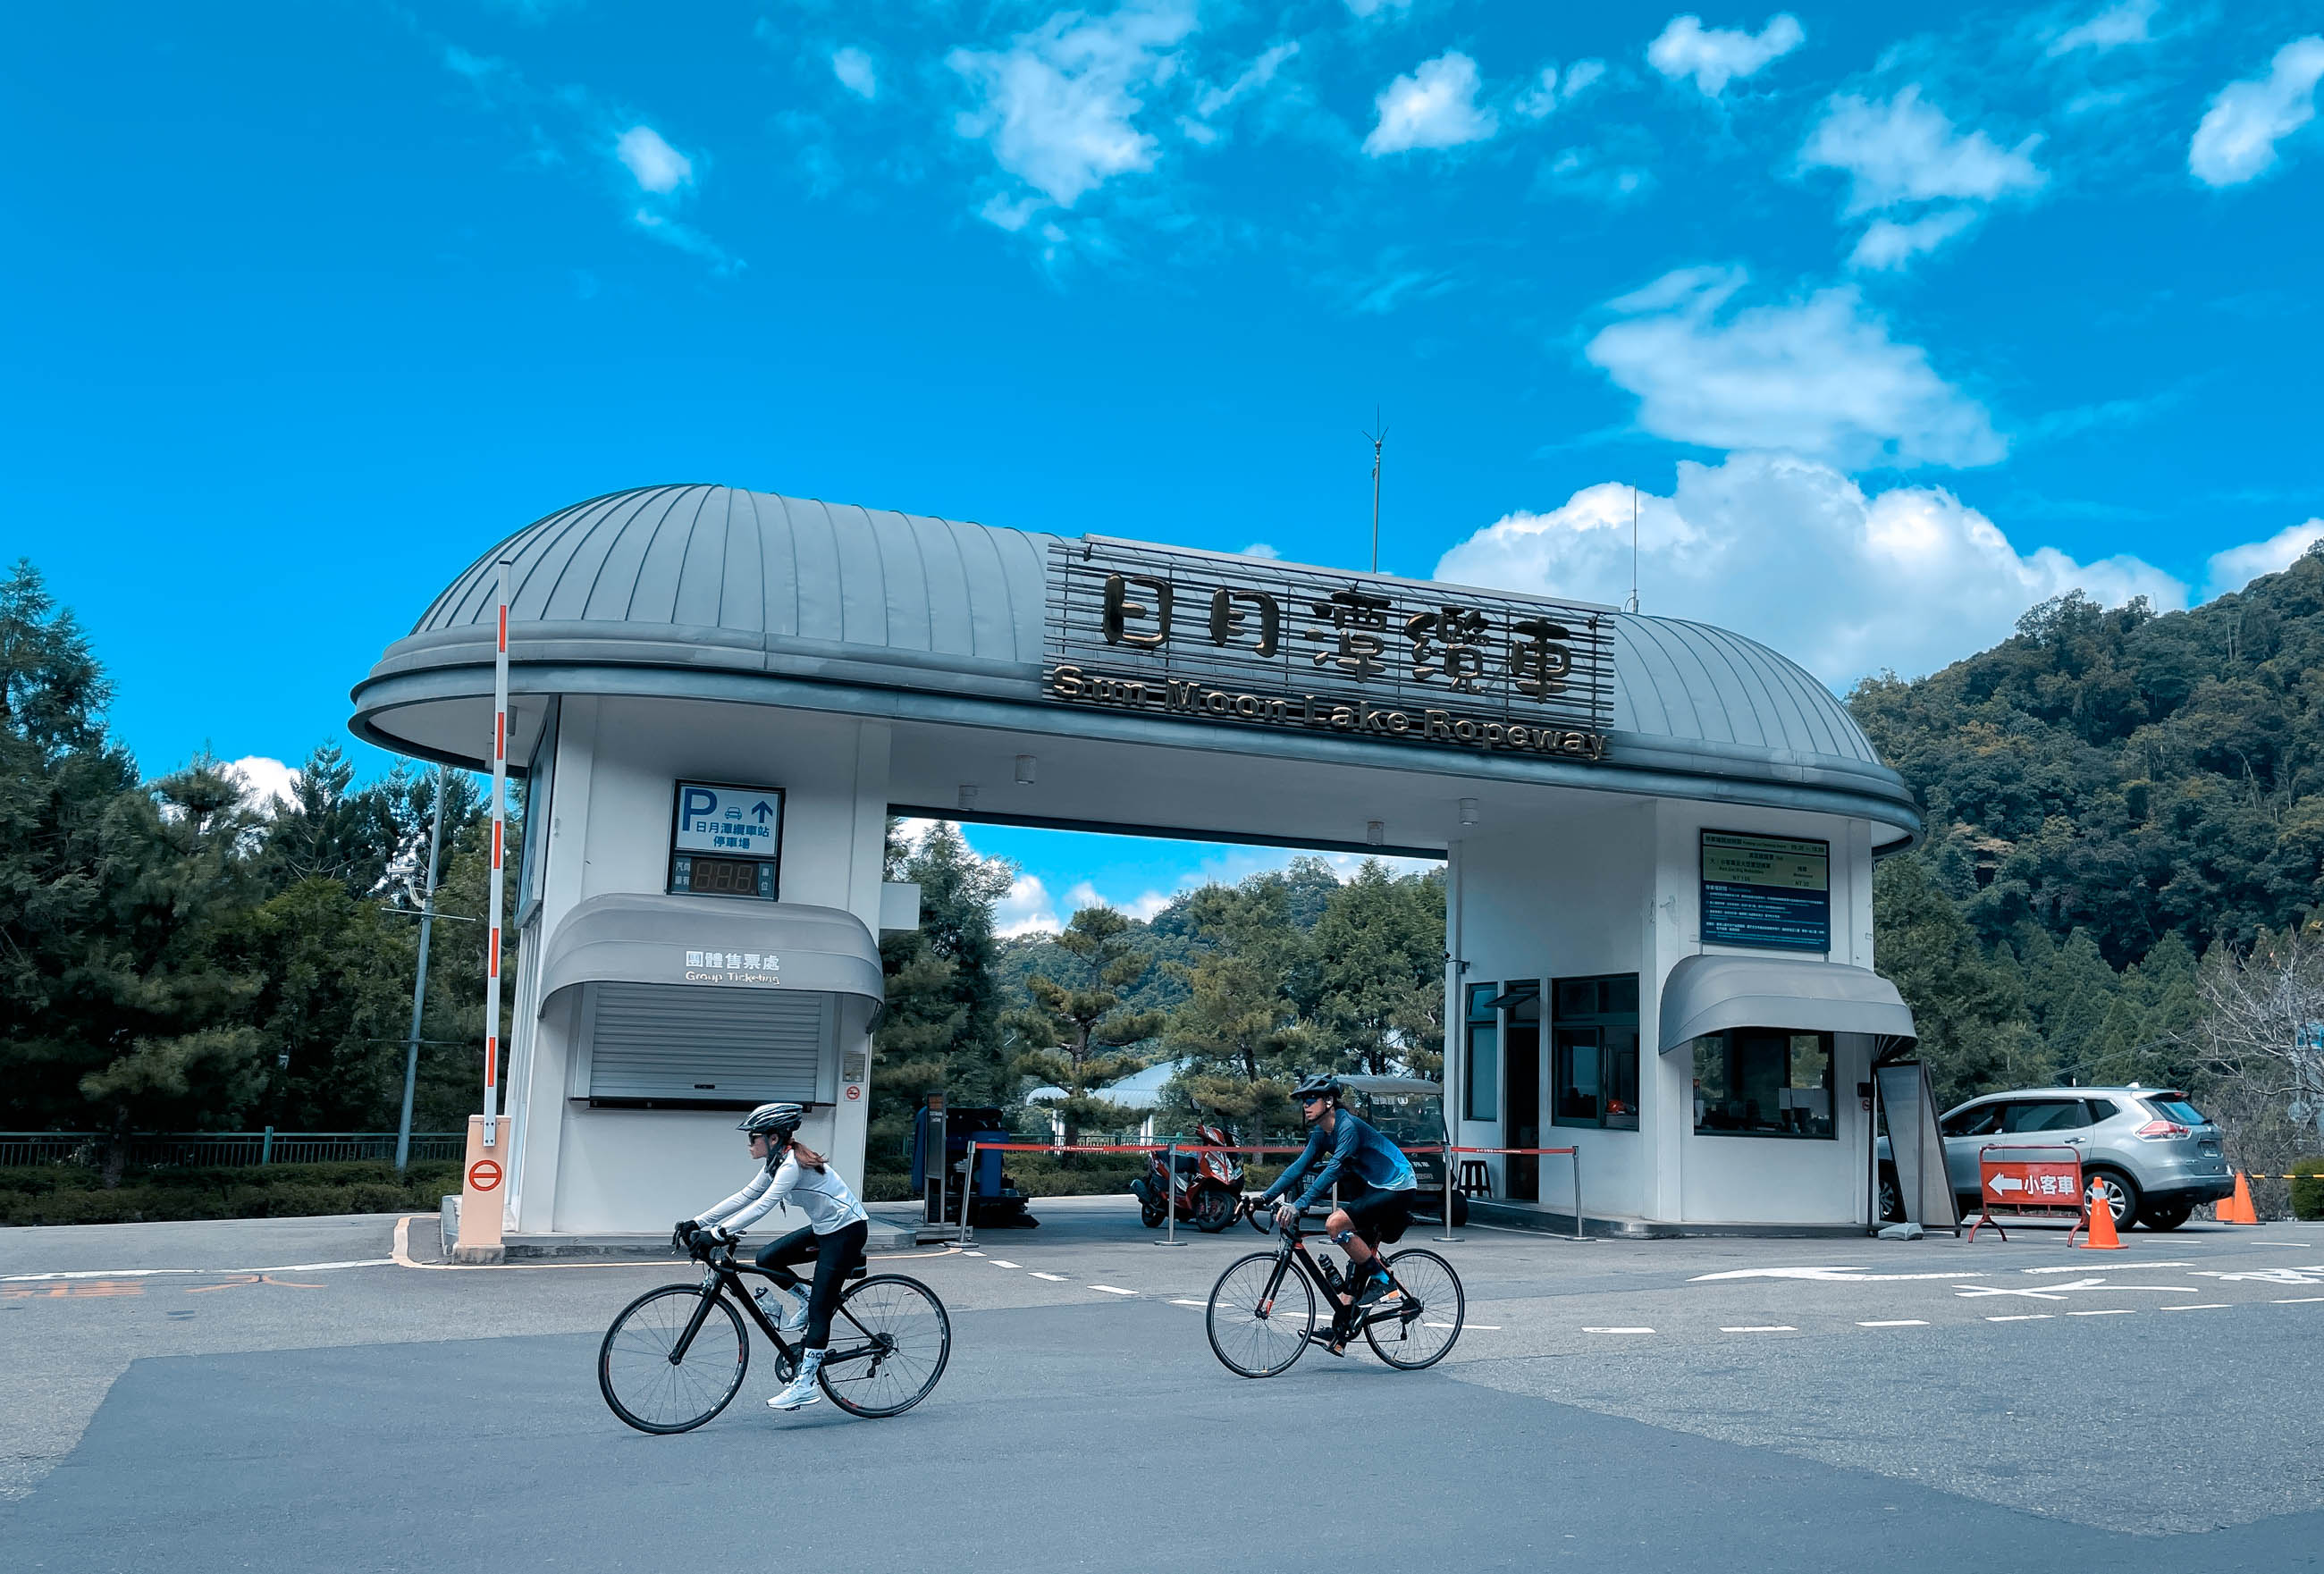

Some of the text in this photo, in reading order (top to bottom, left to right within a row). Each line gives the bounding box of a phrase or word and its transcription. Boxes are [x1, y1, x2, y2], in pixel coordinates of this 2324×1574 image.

[1052, 665, 1607, 761] Sun Moon Lake Ropeway
[682, 787, 718, 832] P
[713, 836, 751, 850] 停車場
[686, 950, 779, 971] 團體售票處
[685, 970, 780, 986] Group Ticketing
[2024, 1174, 2076, 1195] 小客車
